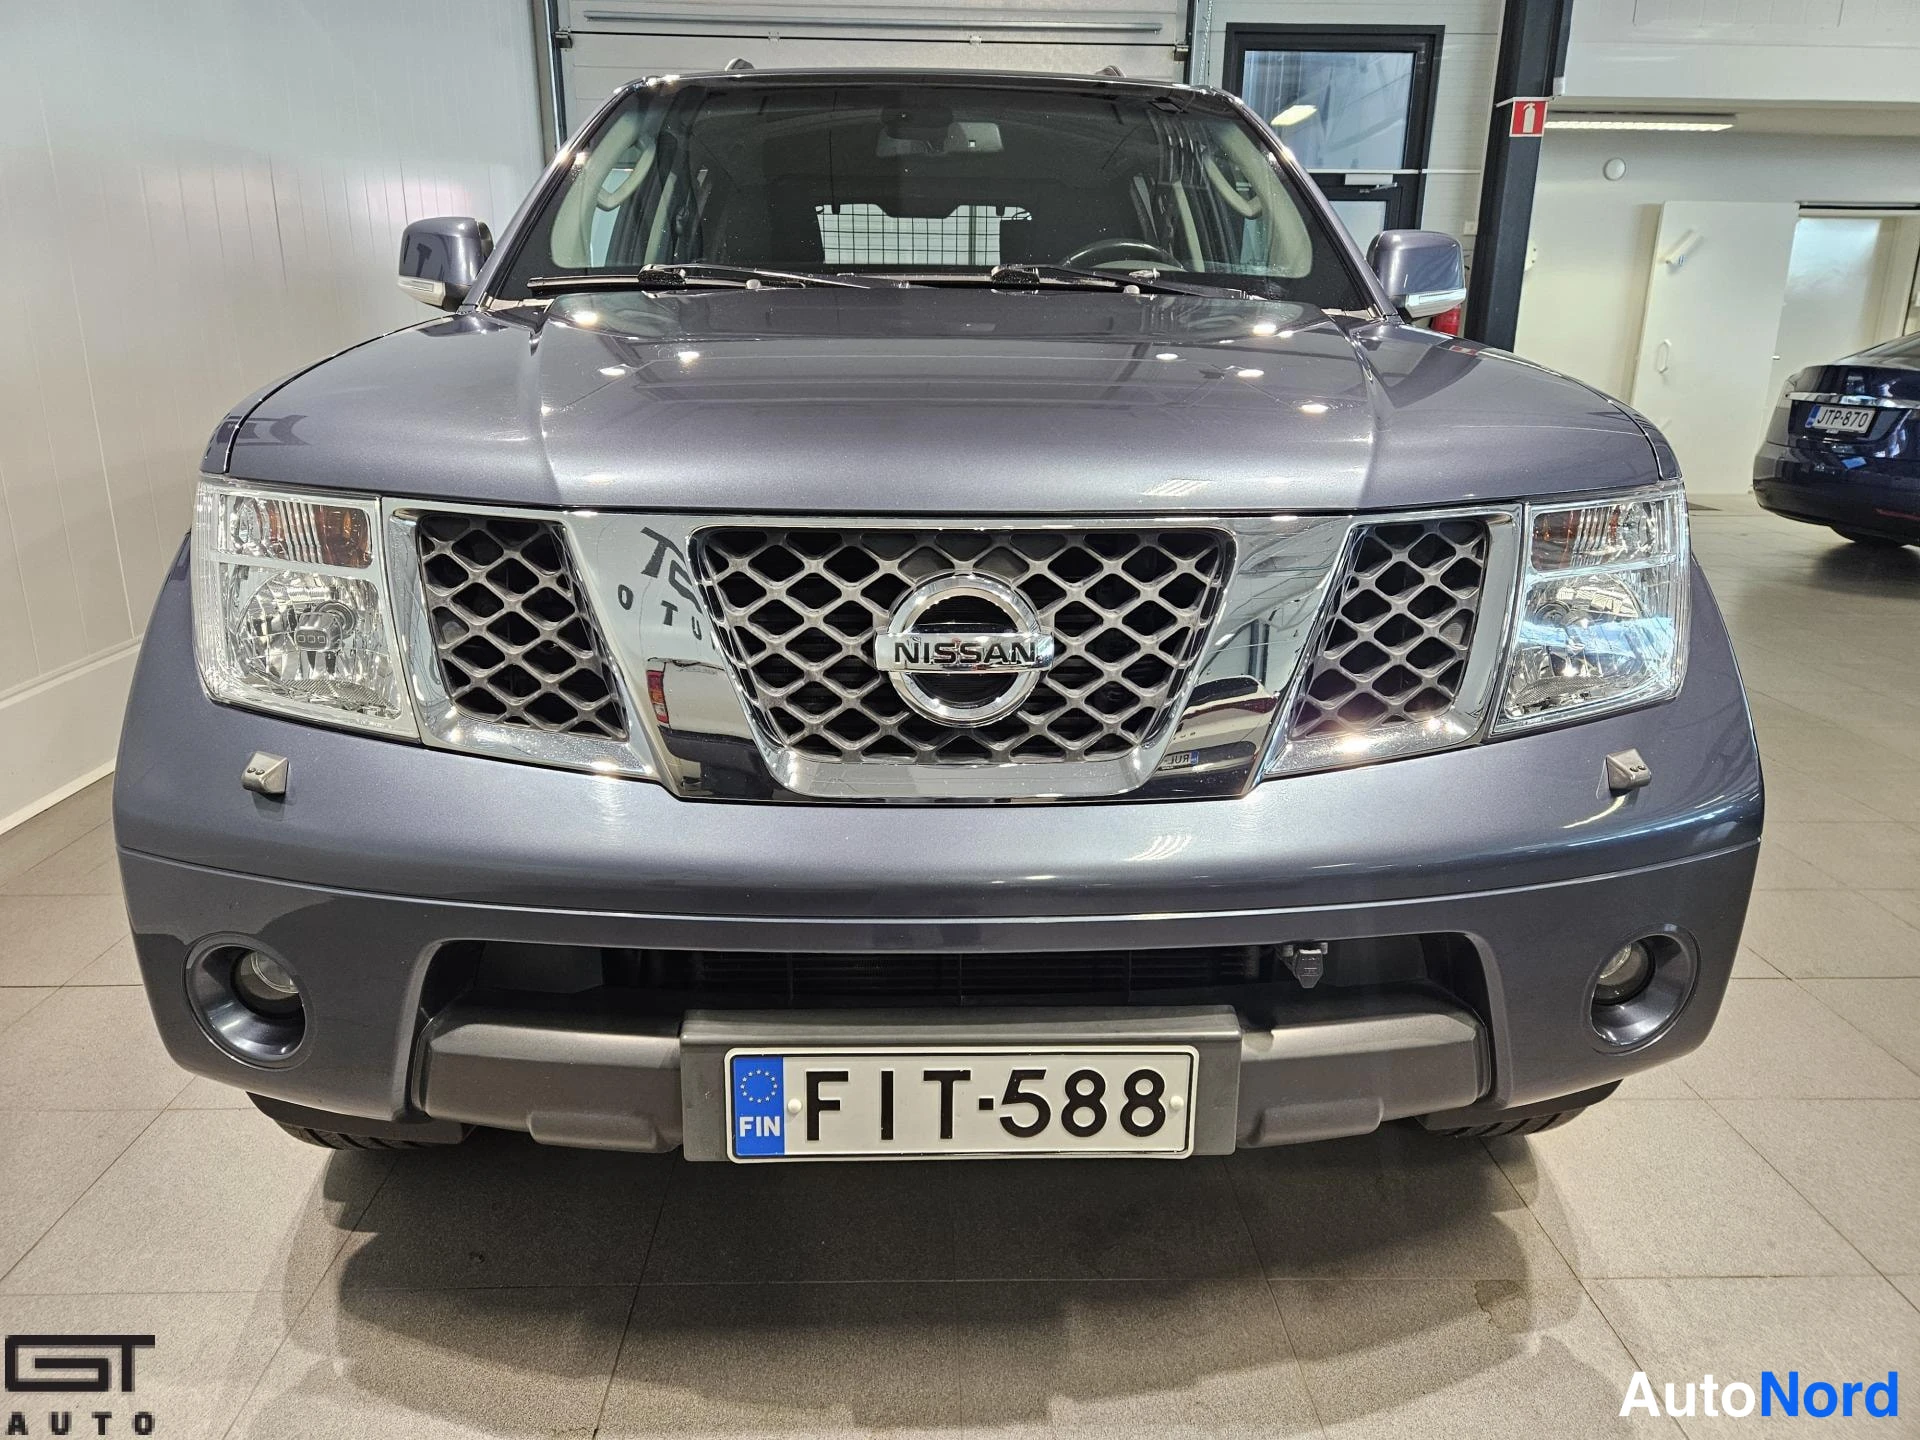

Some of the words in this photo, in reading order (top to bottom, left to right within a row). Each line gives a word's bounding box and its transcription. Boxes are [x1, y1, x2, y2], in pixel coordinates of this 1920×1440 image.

[1817, 408, 1869, 428] JTP-870
[894, 641, 1036, 664] NISSAN
[805, 1068, 1167, 1141] FIT-588
[738, 1115, 781, 1137] FIN
